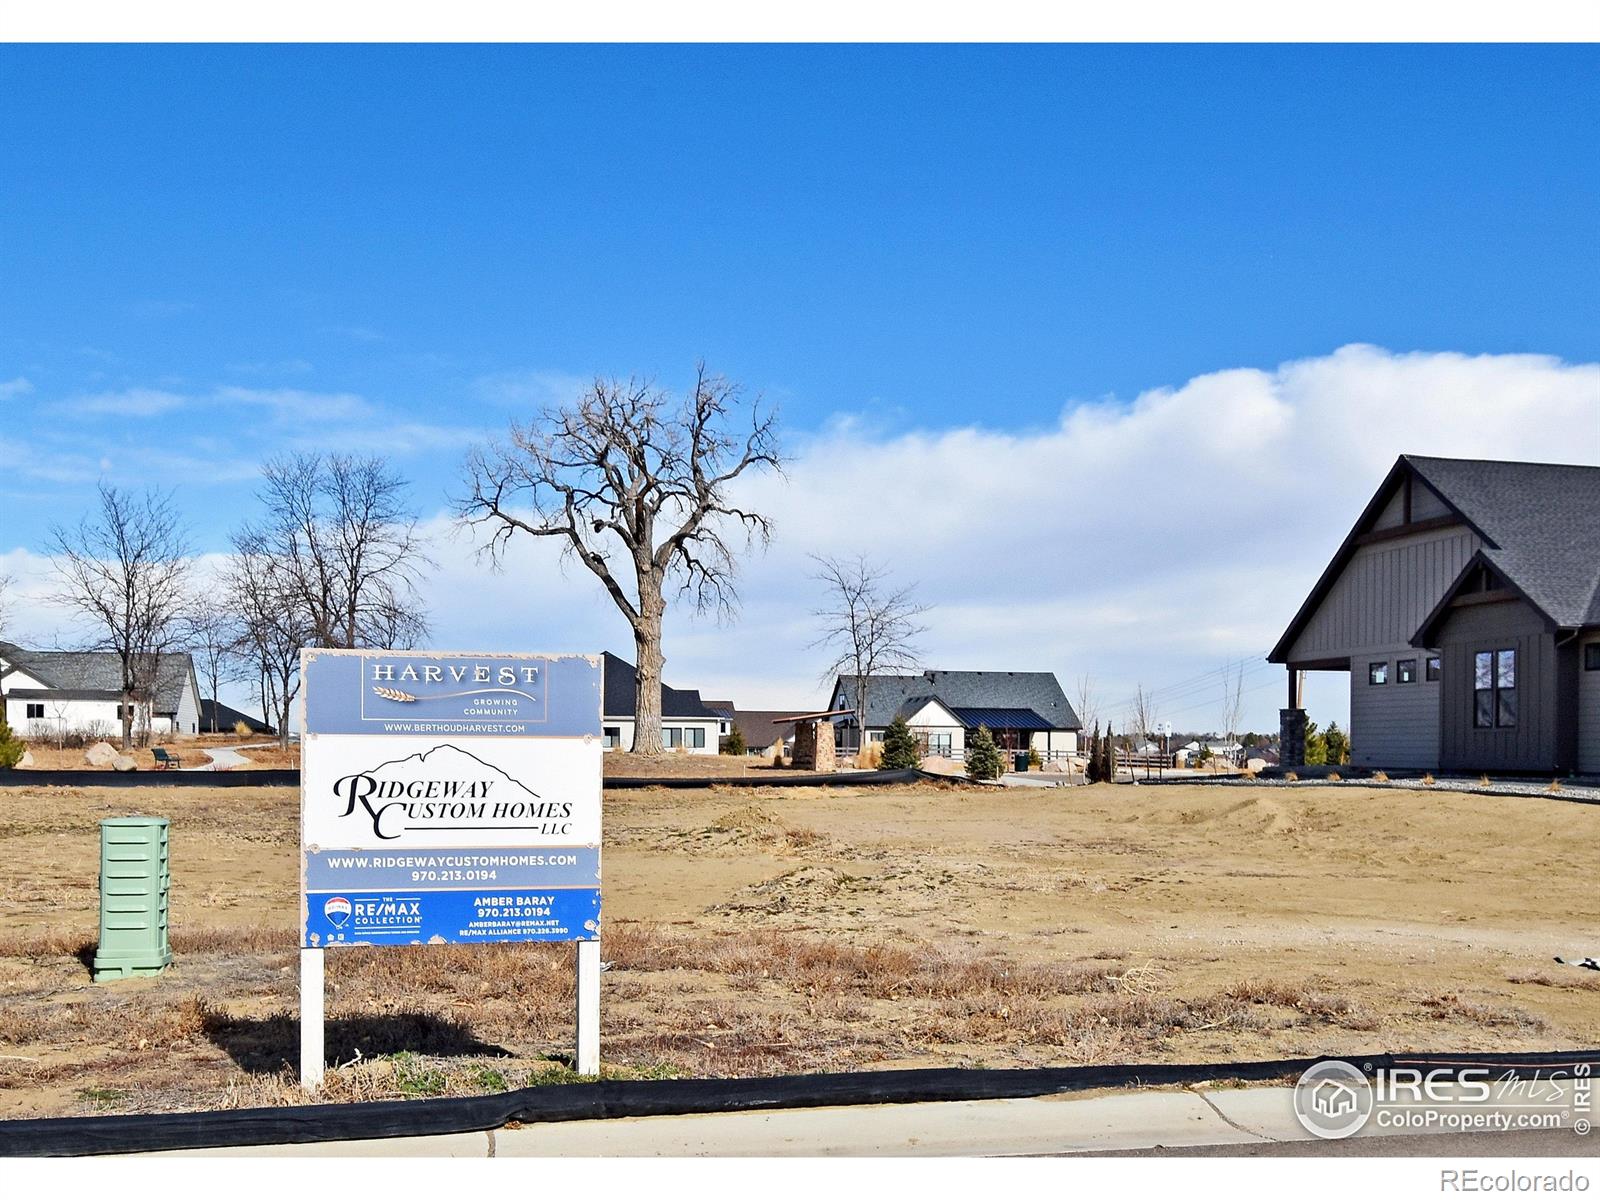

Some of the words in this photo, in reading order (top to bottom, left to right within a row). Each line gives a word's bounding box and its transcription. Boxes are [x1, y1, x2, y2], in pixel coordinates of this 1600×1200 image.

[371, 663, 538, 686] HARVEST
[463, 708, 518, 716] COMMUNITY
[384, 723, 525, 733] WWW.BERTHOUDHARVEST.COM
[492, 802, 573, 818] HOMES
[541, 823, 573, 835] LLC
[328, 855, 577, 868] WWW.RIDGEWAYCUSTOMHOMES.COM
[412, 870, 497, 881] 970.213.0194
[474, 897, 513, 907] AMBER
[516, 896, 555, 906] BARAY
[355, 903, 420, 916] RE/MAX
[477, 907, 551, 918] 970.213.0194
[355, 916, 421, 925] COLLECTION
[468, 920, 560, 928] AMBERBARAY@REMAX.NET
